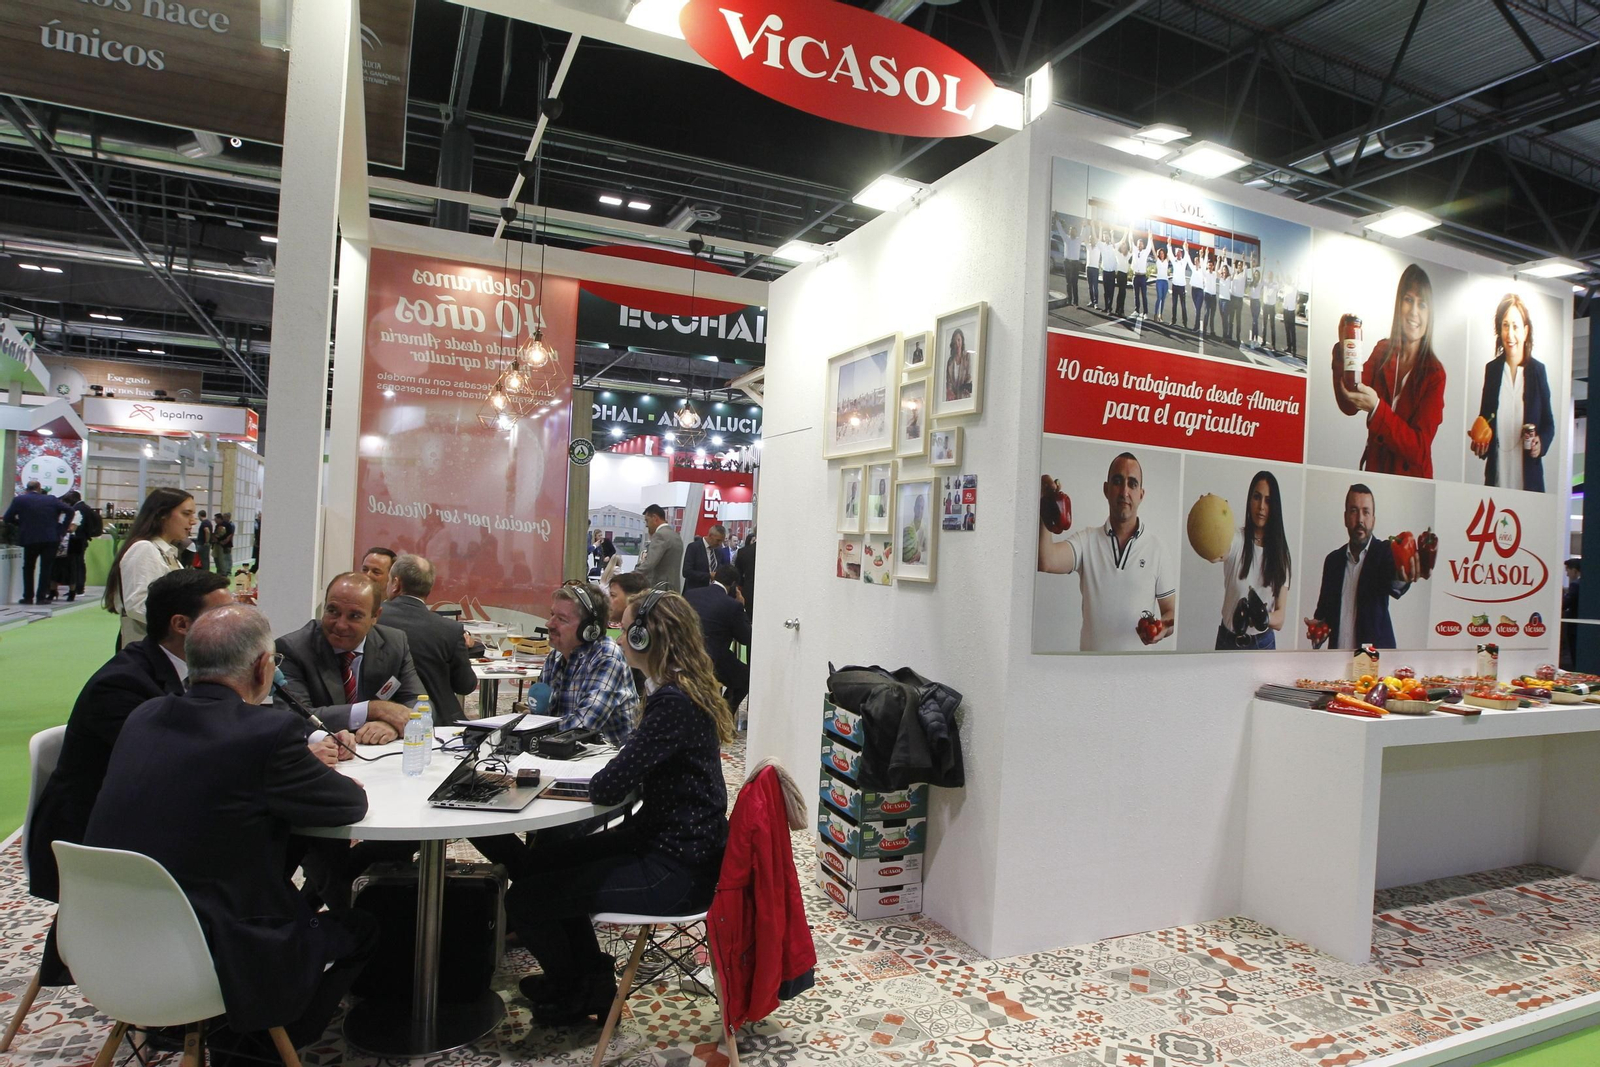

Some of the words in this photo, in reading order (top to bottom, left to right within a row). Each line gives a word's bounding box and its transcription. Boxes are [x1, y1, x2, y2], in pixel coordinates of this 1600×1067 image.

[39, 18, 165, 71] únicos
[107, 373, 124, 382] Ese
[124, 376, 151, 385] gusto
[118, 387, 134, 395] nos
[1056, 357, 1081, 381] 40
[1082, 365, 1120, 388] años
[1122, 370, 1204, 400] trabajando
[1205, 384, 1243, 407] desde
[1246, 389, 1300, 415] Almería
[160, 409, 203, 421] lapalma
[1102, 399, 1150, 425] para
[1153, 403, 1171, 426] el
[1173, 408, 1260, 437] agricultor
[704, 489, 721, 500] LA
[1466, 497, 1522, 562] 40
